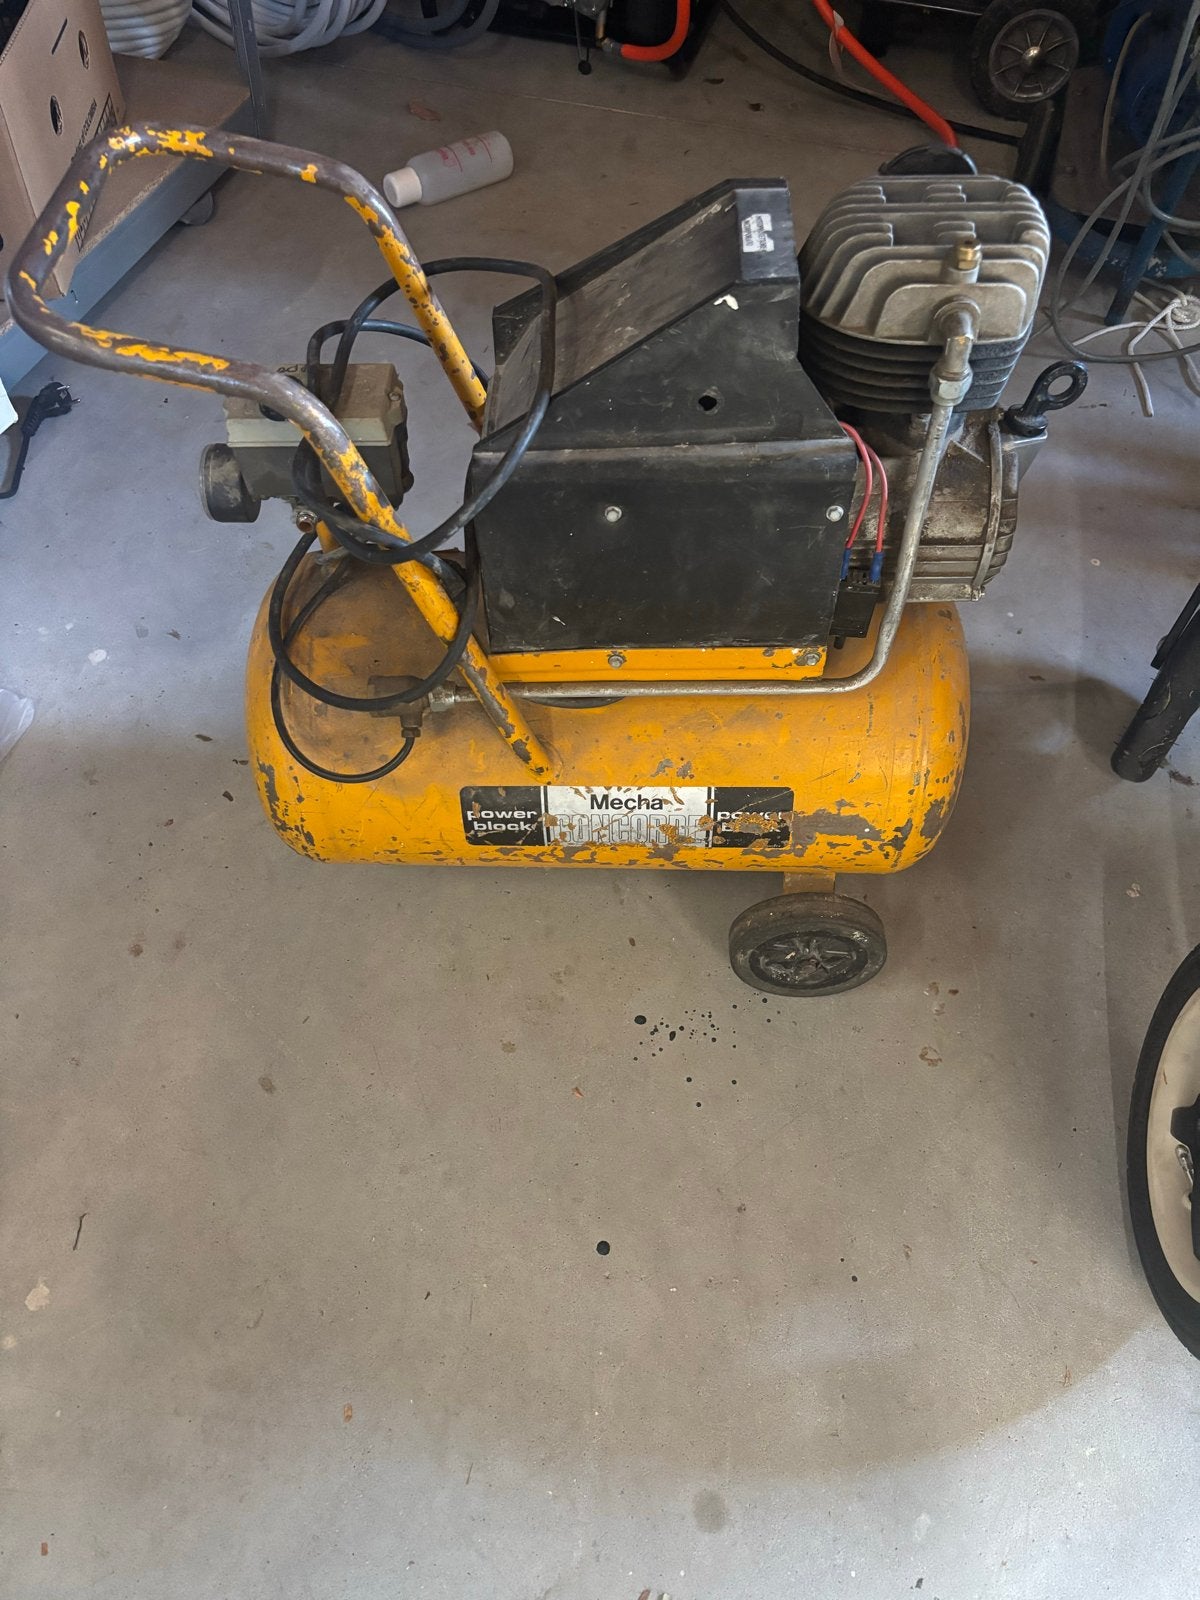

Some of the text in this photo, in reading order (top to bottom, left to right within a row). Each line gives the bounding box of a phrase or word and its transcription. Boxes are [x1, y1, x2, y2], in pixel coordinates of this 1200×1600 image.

[590, 794, 664, 810] Mecha
[466, 810, 538, 821] power
[473, 821, 533, 831] block
